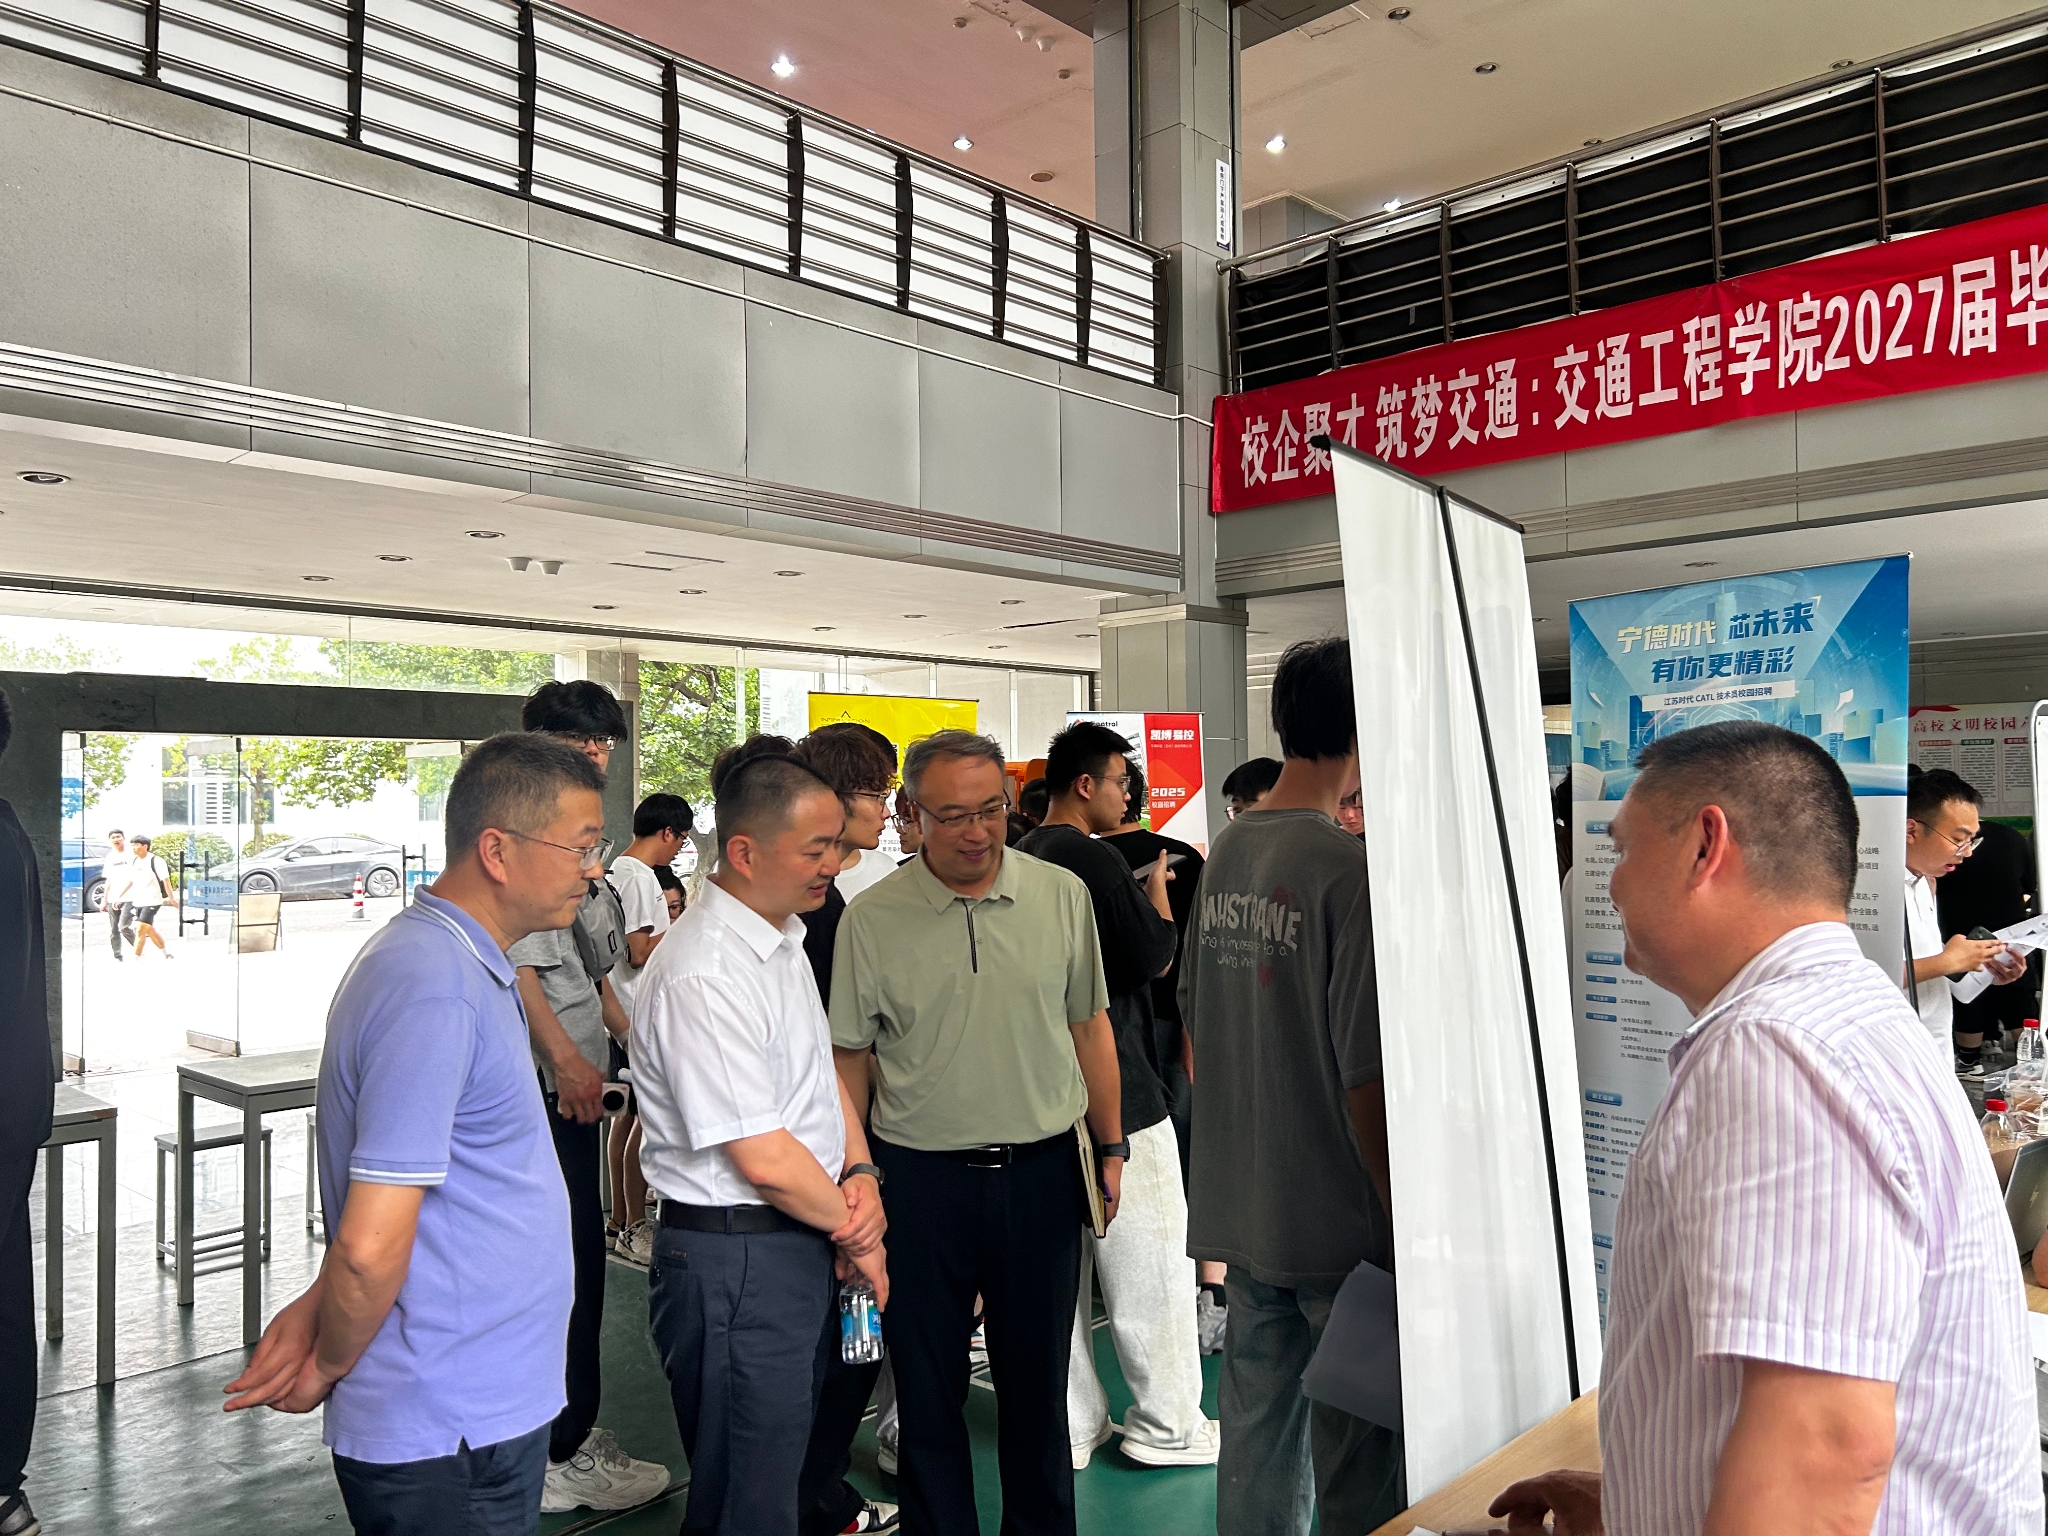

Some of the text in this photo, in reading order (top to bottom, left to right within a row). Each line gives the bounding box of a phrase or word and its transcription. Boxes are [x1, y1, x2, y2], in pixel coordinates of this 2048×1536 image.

[1616, 601, 1815, 655] 宁德时代 芯未来
[1651, 645, 1797, 684] 有你更精彩
[1663, 686, 1773, 706] 江苏时代 CATL 技术员校园招聘
[1150, 729, 1195, 741] 凯博易控
[1151, 787, 1186, 797] 2025
[1151, 800, 1176, 809] 校园招聘
